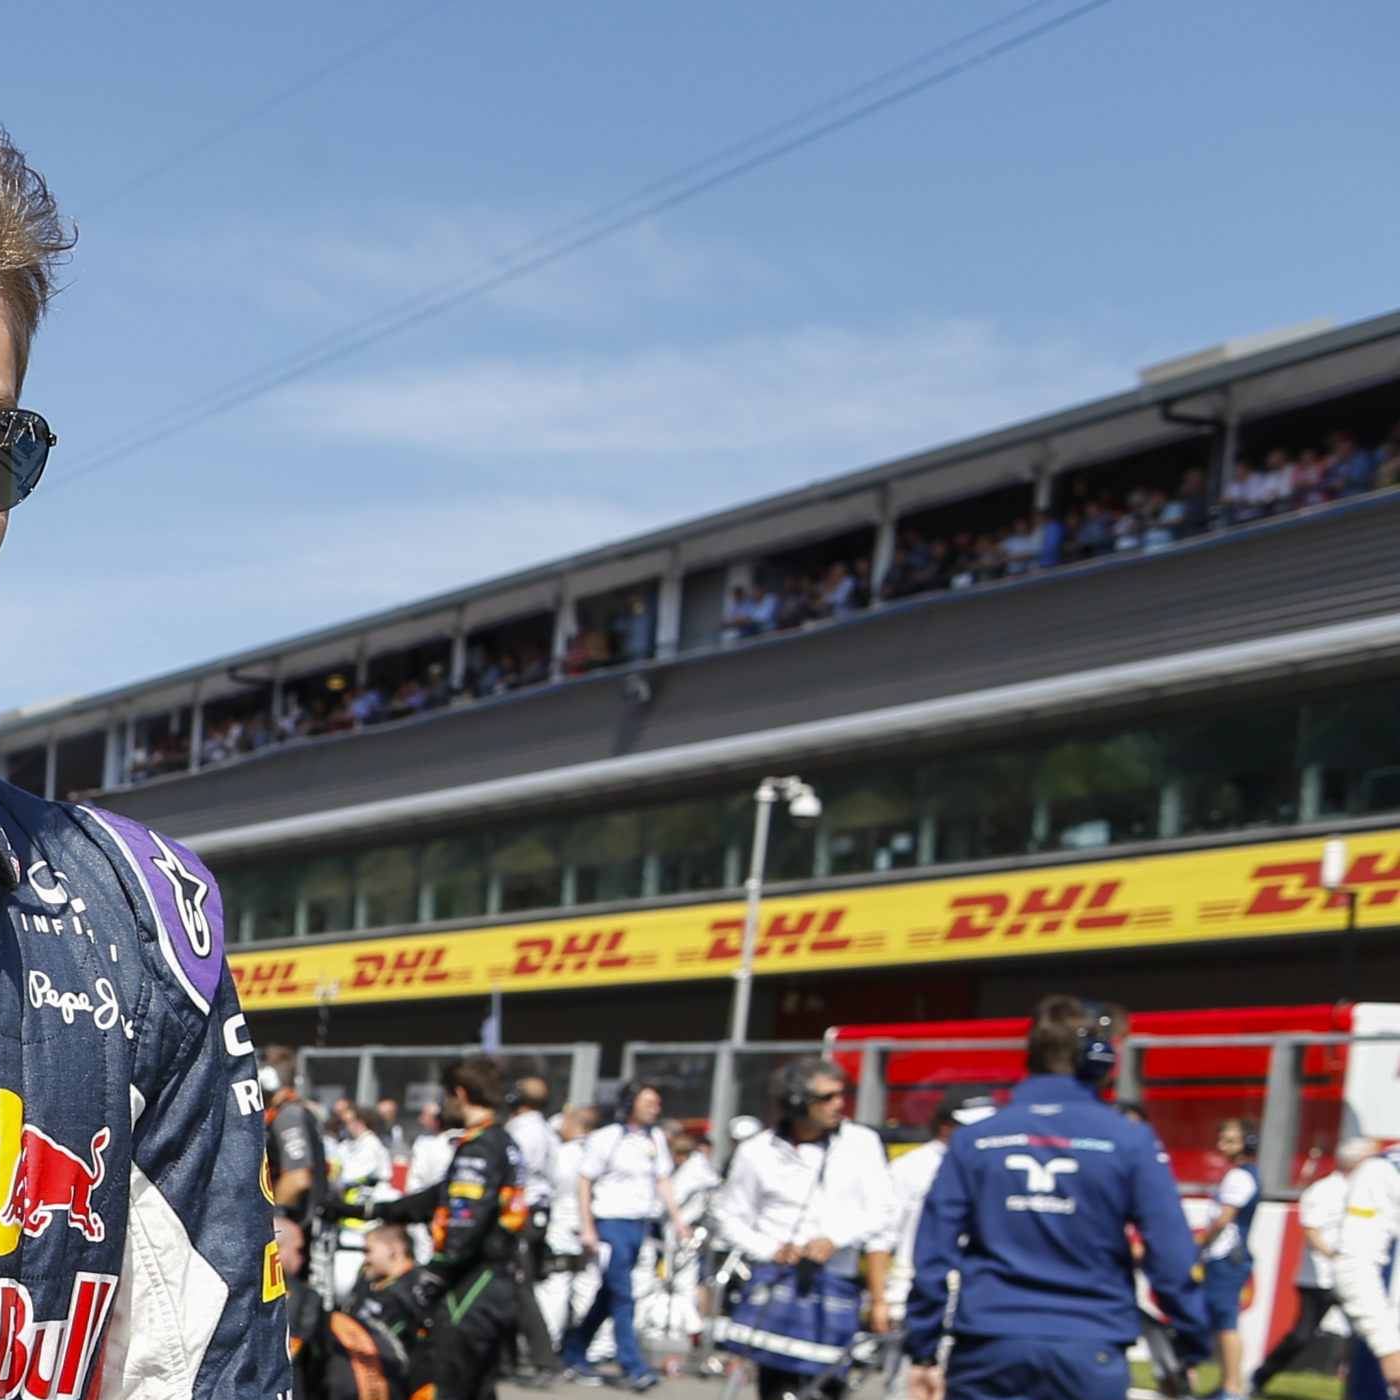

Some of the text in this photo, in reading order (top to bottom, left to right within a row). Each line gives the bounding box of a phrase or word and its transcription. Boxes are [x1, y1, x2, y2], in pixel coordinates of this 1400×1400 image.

[706, 909, 851, 960] DHL
[943, 882, 1131, 941] DHL
[352, 948, 449, 988] DHL
[512, 930, 630, 976] DHL
[28, 969, 93, 1024] Pepe
